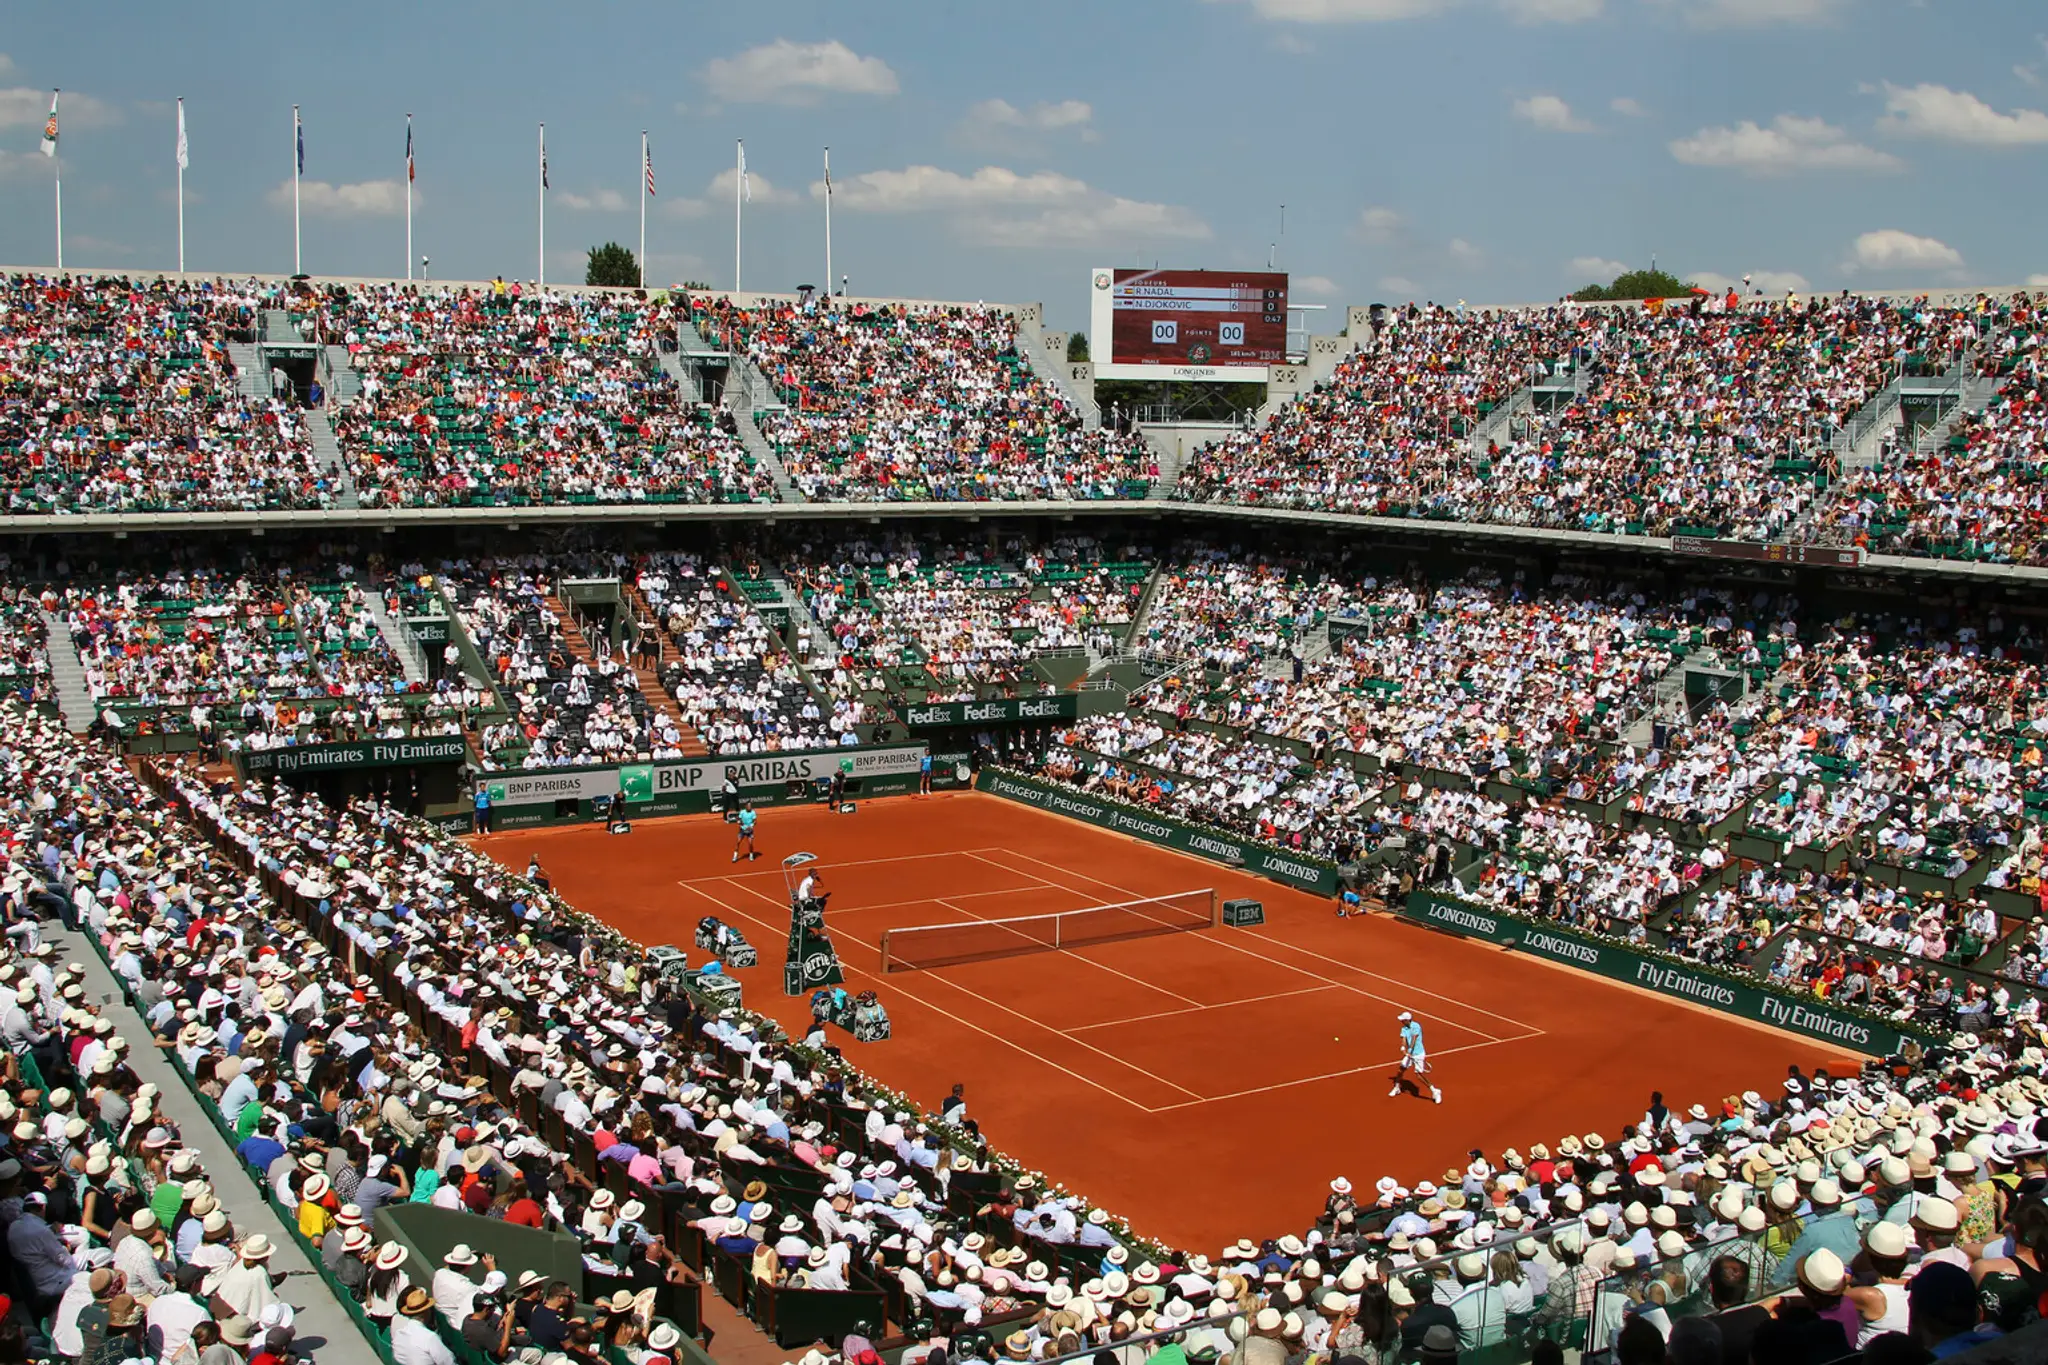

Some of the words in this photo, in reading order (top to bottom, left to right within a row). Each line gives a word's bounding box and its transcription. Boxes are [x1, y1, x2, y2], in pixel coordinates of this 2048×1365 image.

[1135, 287, 1175, 296] R.NADAL
[1268, 290, 1275, 298] 0
[1135, 300, 1192, 309] N.DJOKOVIC
[1232, 303, 1238, 311] 6
[1268, 302, 1275, 311] 0
[1155, 325, 1175, 339] 00
[1222, 326, 1242, 340] 00
[289, 349, 314, 358] FedEx
[1259, 350, 1281, 360] IBM
[908, 706, 951, 724] FedEx
[963, 702, 1006, 720] FedEx
[1018, 700, 1060, 716] FedEx
[249, 753, 272, 769] IBM
[856, 755, 876, 767] BNP
[878, 752, 918, 764] PARIBAS
[933, 753, 968, 761] LONGINES
[659, 767, 703, 789] BNP
[724, 758, 811, 783] PARIBAS
[509, 782, 532, 794] BNP
[534, 778, 581, 792] PARIBAS
[998, 781, 1044, 801] PEUGEOT
[1053, 797, 1103, 818] PEUGEOT
[1118, 814, 1173, 839] PEUGEOT
[1188, 834, 1241, 859] LONGINES
[1262, 856, 1320, 883] LONGINES
[1238, 906, 1260, 921] IBM
[1428, 903, 1497, 934] LONGINES
[1523, 930, 1599, 964] LONGINES
